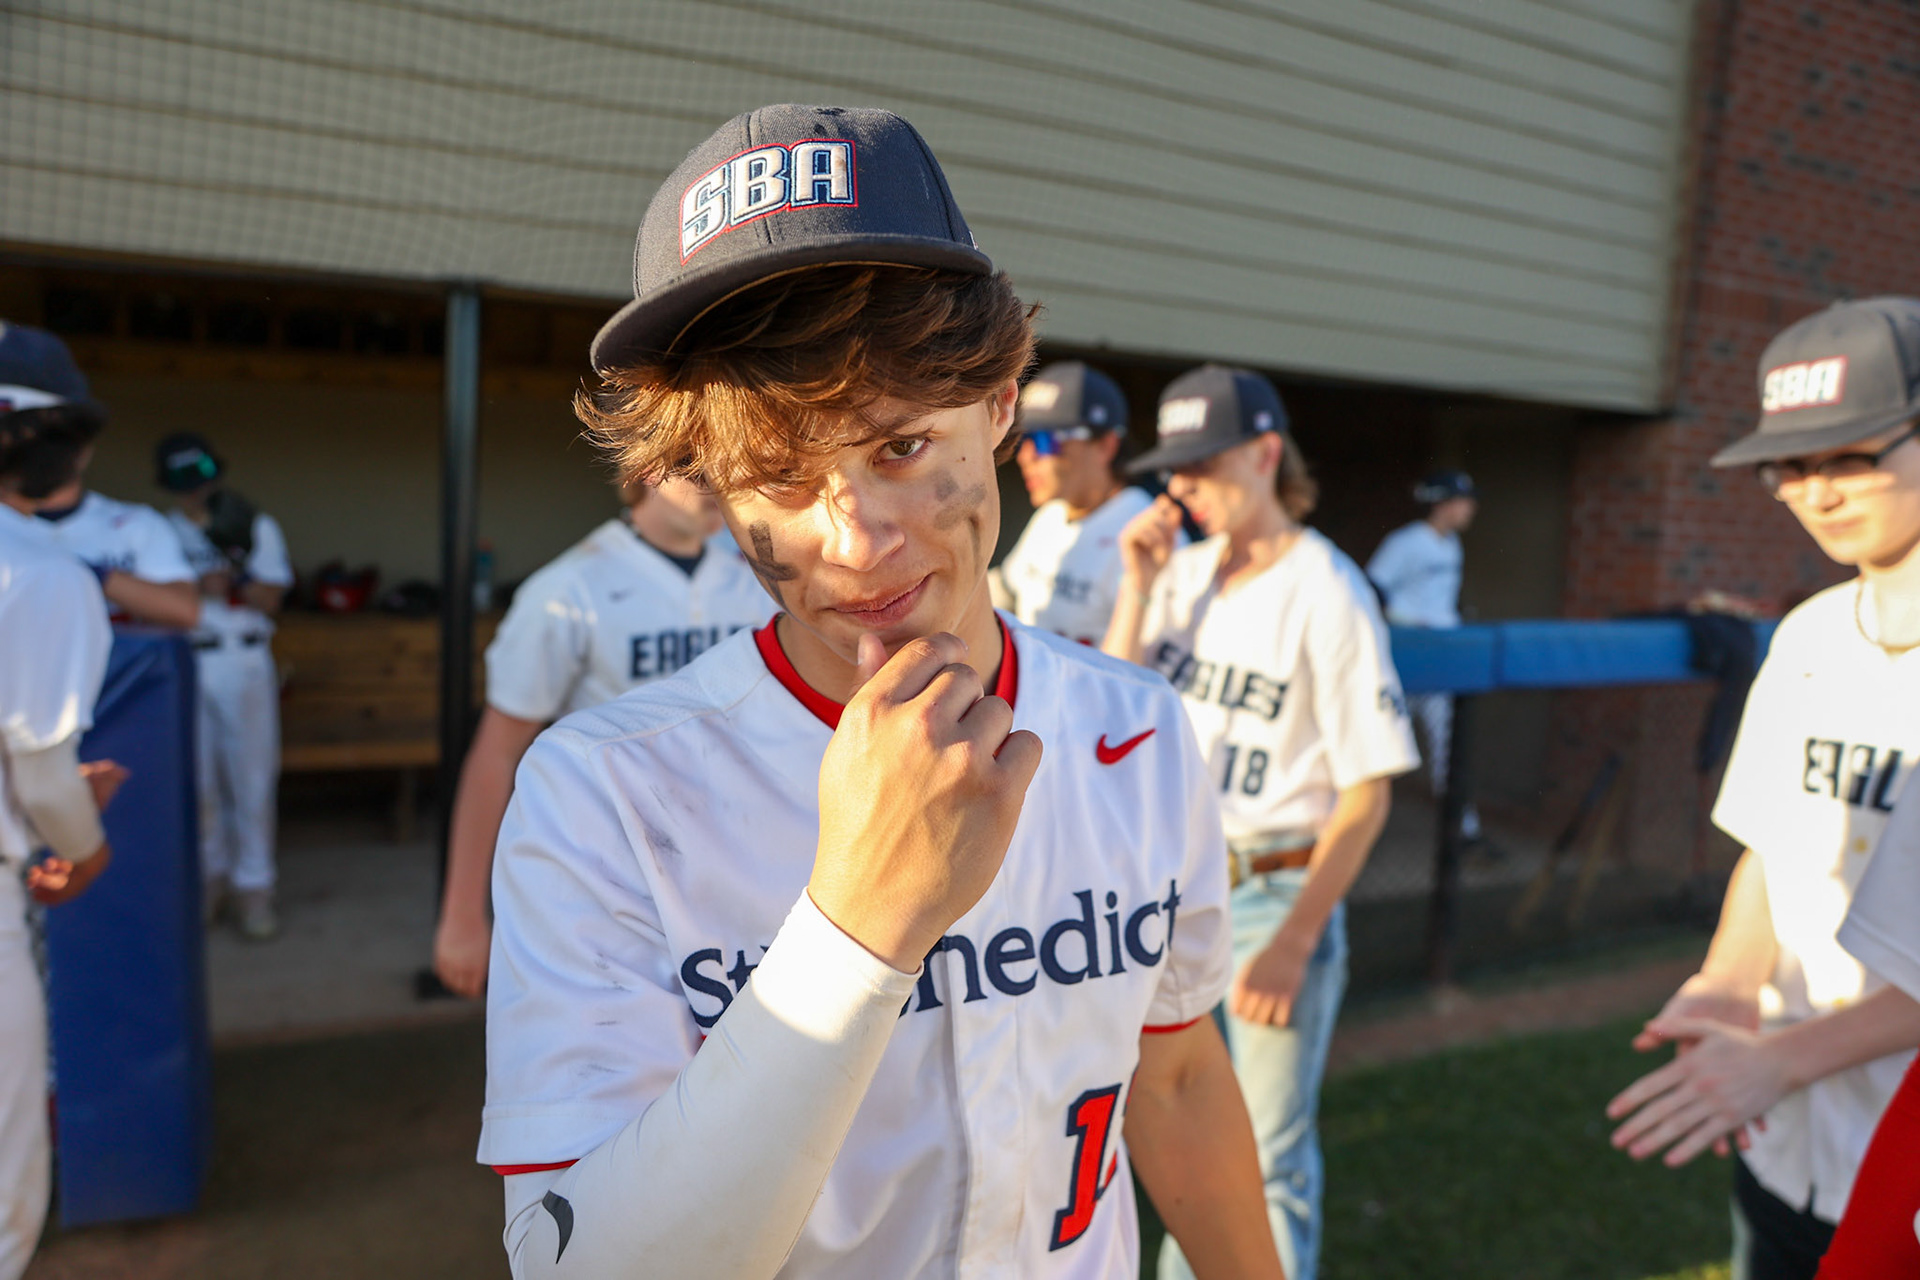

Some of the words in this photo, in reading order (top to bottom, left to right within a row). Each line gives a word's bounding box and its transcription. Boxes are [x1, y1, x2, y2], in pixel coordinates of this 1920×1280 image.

[679, 138, 858, 266] SBA
[1217, 744, 1270, 797] 18
[760, 879, 1181, 1018] nedict
[1049, 1063, 1138, 1252] 1
